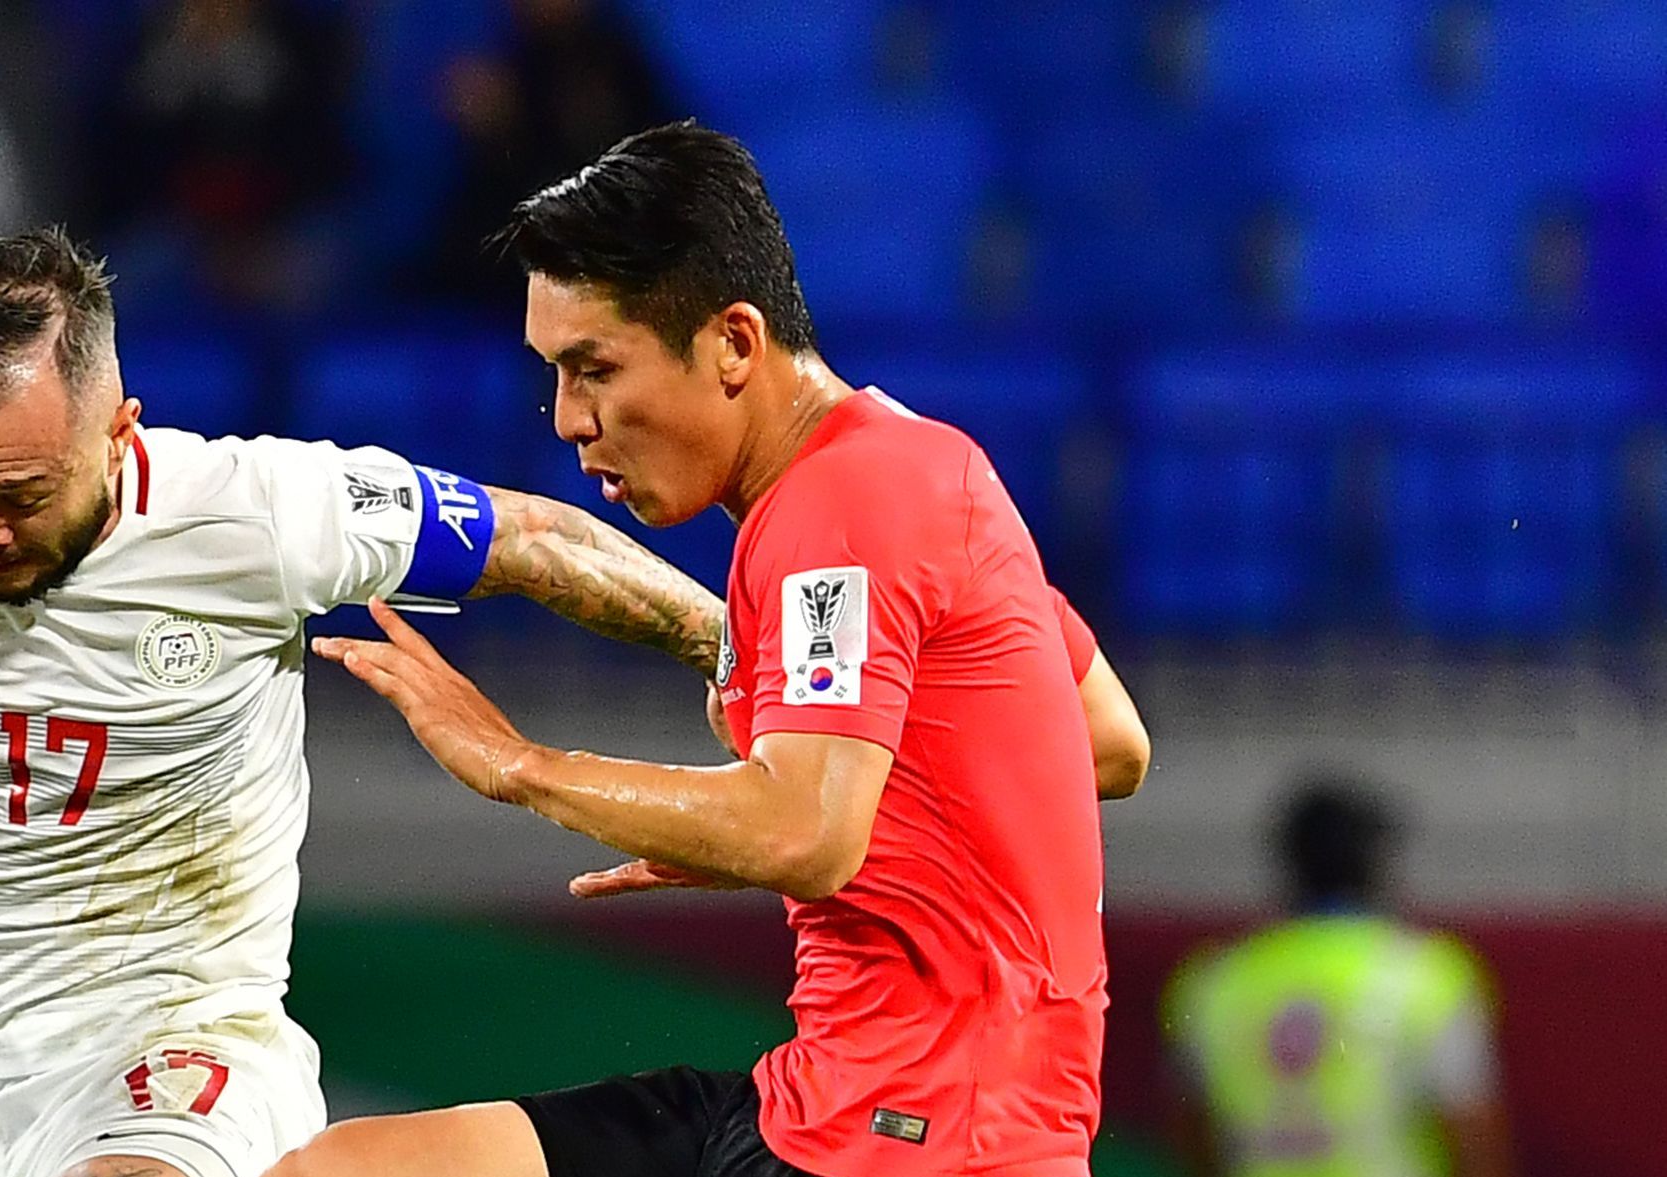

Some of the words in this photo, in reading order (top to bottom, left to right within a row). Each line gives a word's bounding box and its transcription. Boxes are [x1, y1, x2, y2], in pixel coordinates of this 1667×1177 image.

[164, 653, 201, 670] PFF
[0, 711, 109, 827] 17
[124, 1050, 230, 1117] 17
